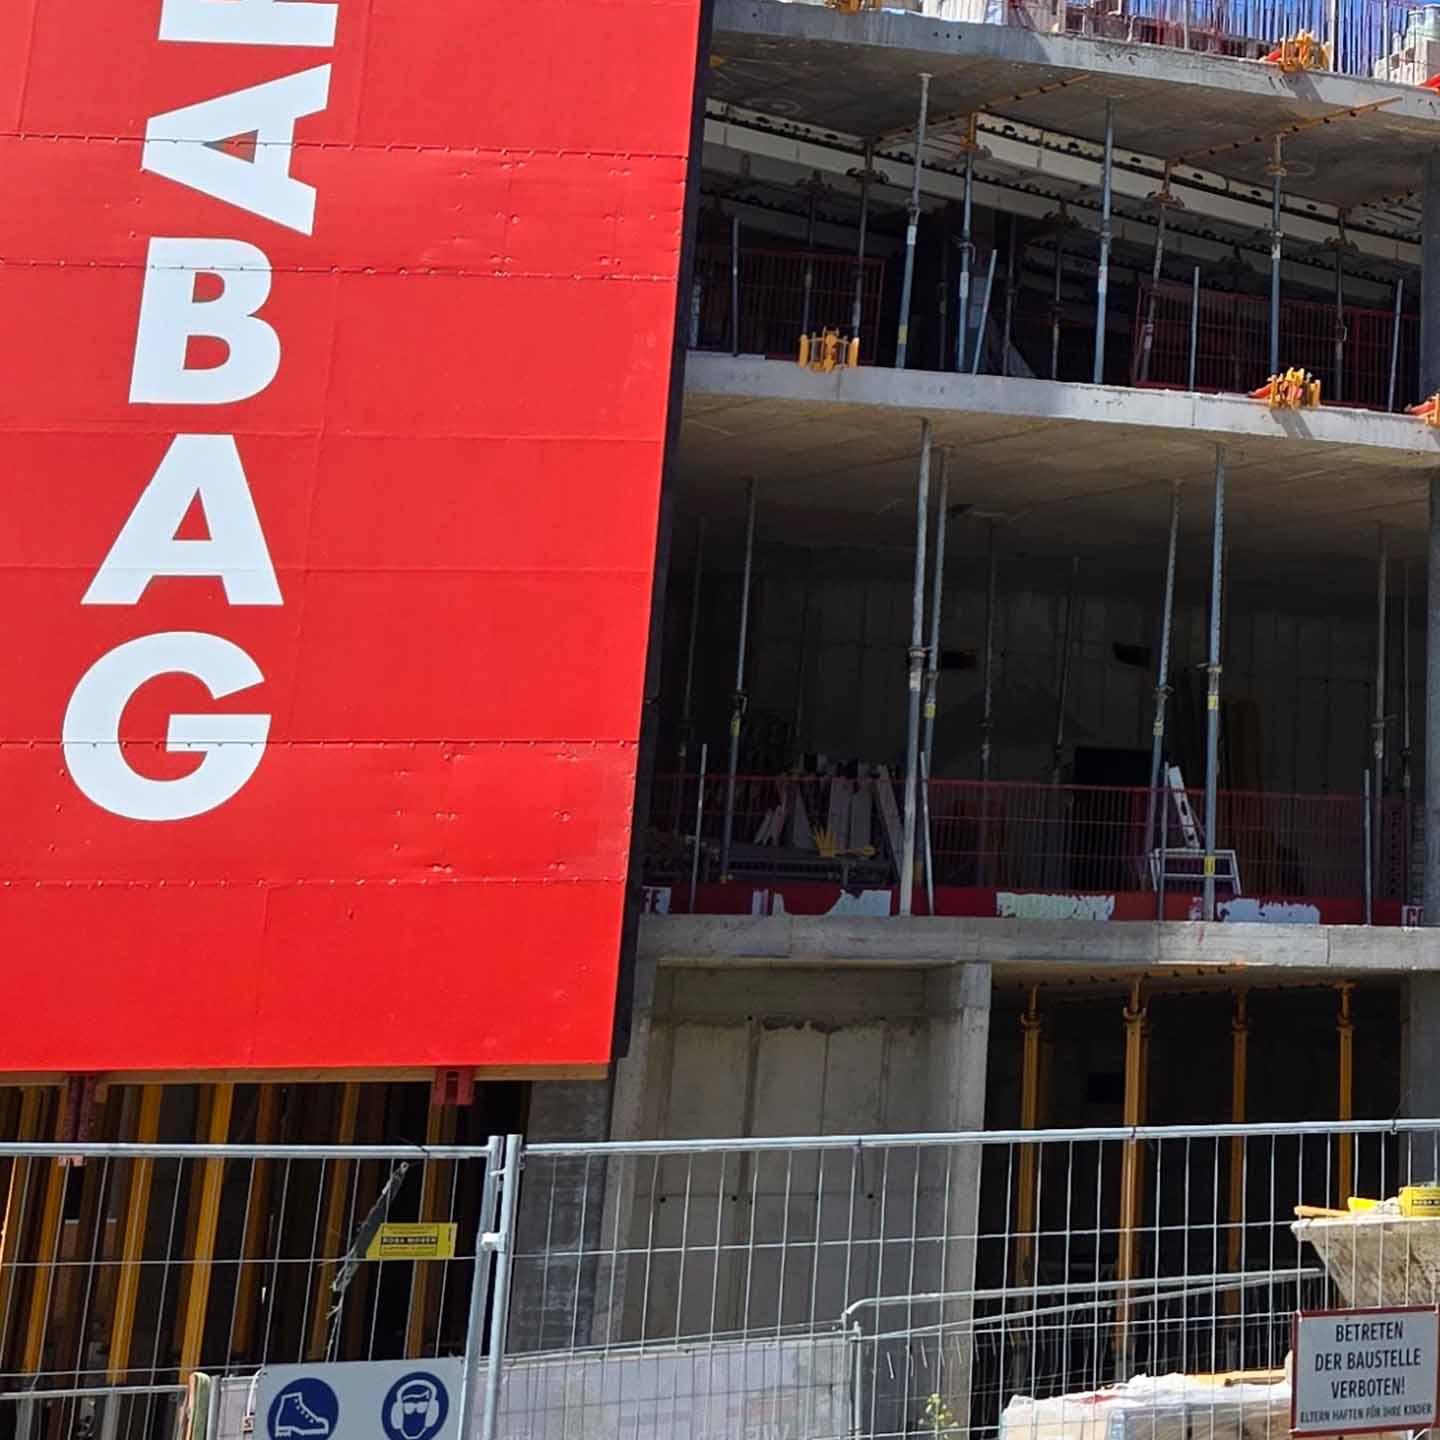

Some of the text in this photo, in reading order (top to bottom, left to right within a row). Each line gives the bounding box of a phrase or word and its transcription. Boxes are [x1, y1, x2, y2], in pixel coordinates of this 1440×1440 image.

[1335, 1321, 1404, 1343] BETRETEN
[1314, 1348, 1422, 1372] DER BAUSTELLE
[1330, 1376, 1406, 1400] VERBOTEN!
[1300, 1411, 1330, 1424] ELTERN
[1332, 1408, 1363, 1421] HAFTEN
[1404, 1403, 1432, 1417] KINDER
